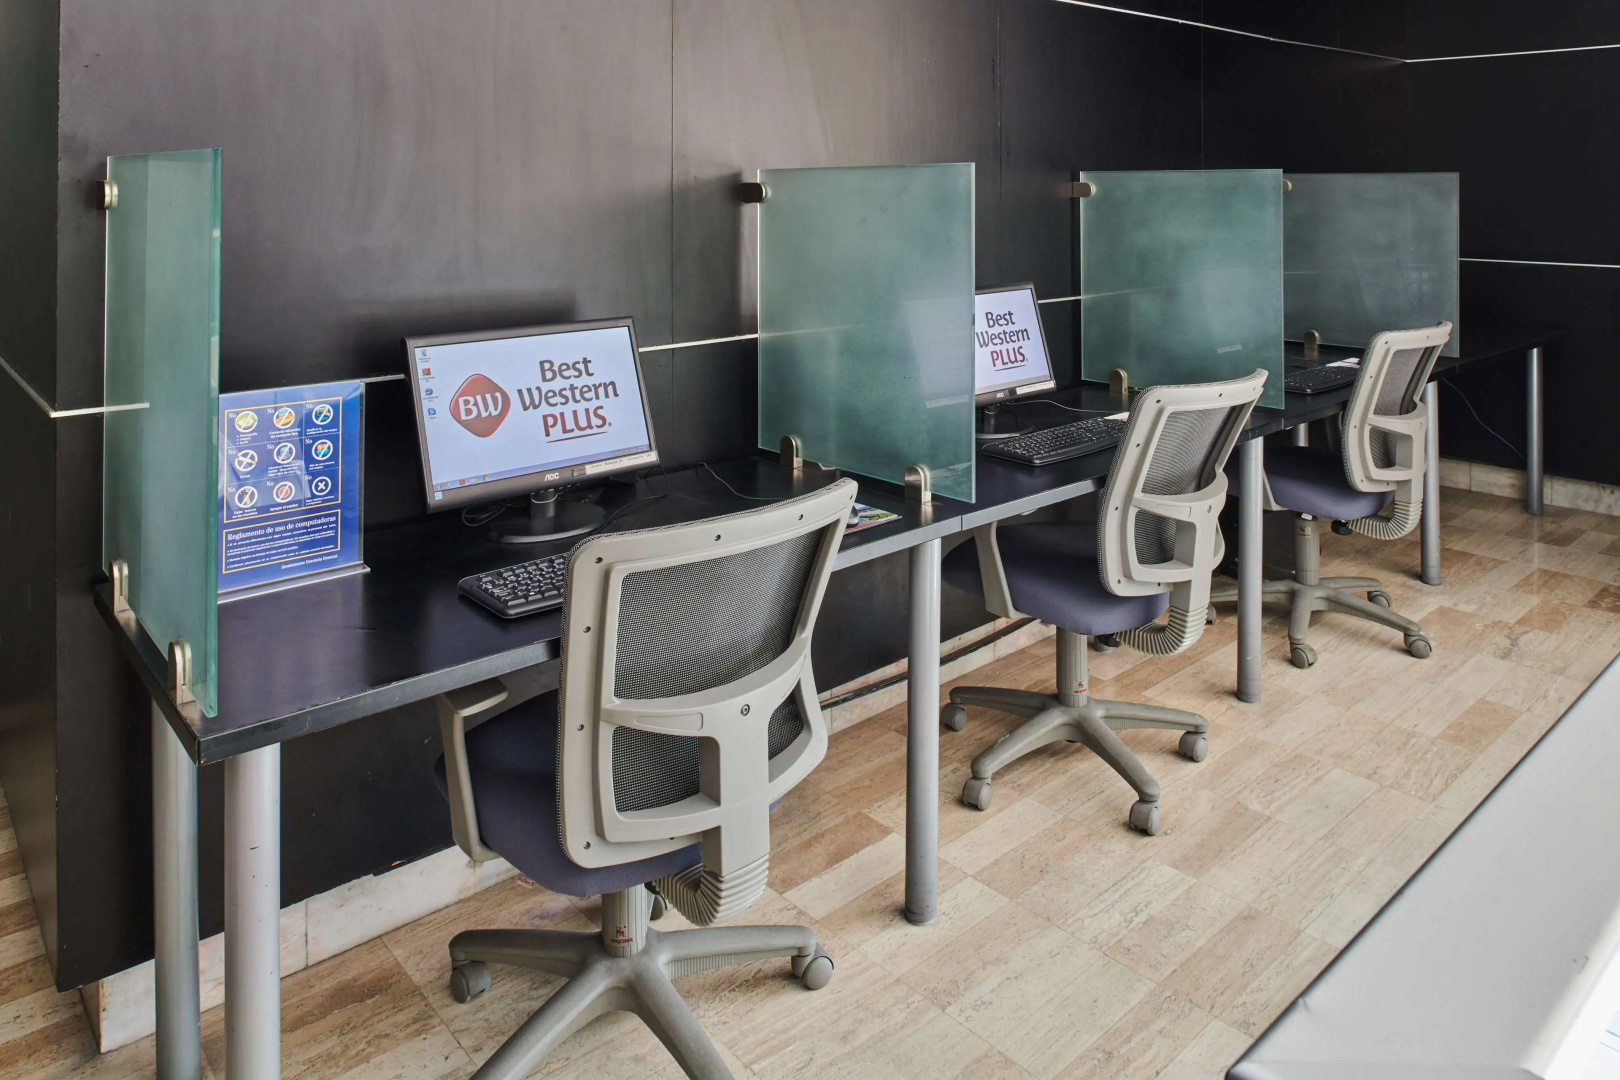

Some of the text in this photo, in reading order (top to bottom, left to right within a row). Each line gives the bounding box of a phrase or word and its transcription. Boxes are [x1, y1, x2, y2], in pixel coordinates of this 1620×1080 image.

[985, 311, 1015, 328] Best
[976, 328, 1030, 348] Western
[990, 346, 1026, 367] PLUS
[538, 357, 594, 383] Best
[458, 390, 502, 421] BW
[516, 380, 620, 411] Western
[542, 405, 607, 438] PLUS
[544, 472, 560, 481] AOC
[227, 529, 264, 540] Reglamento
[295, 516, 336, 527] computadoras
